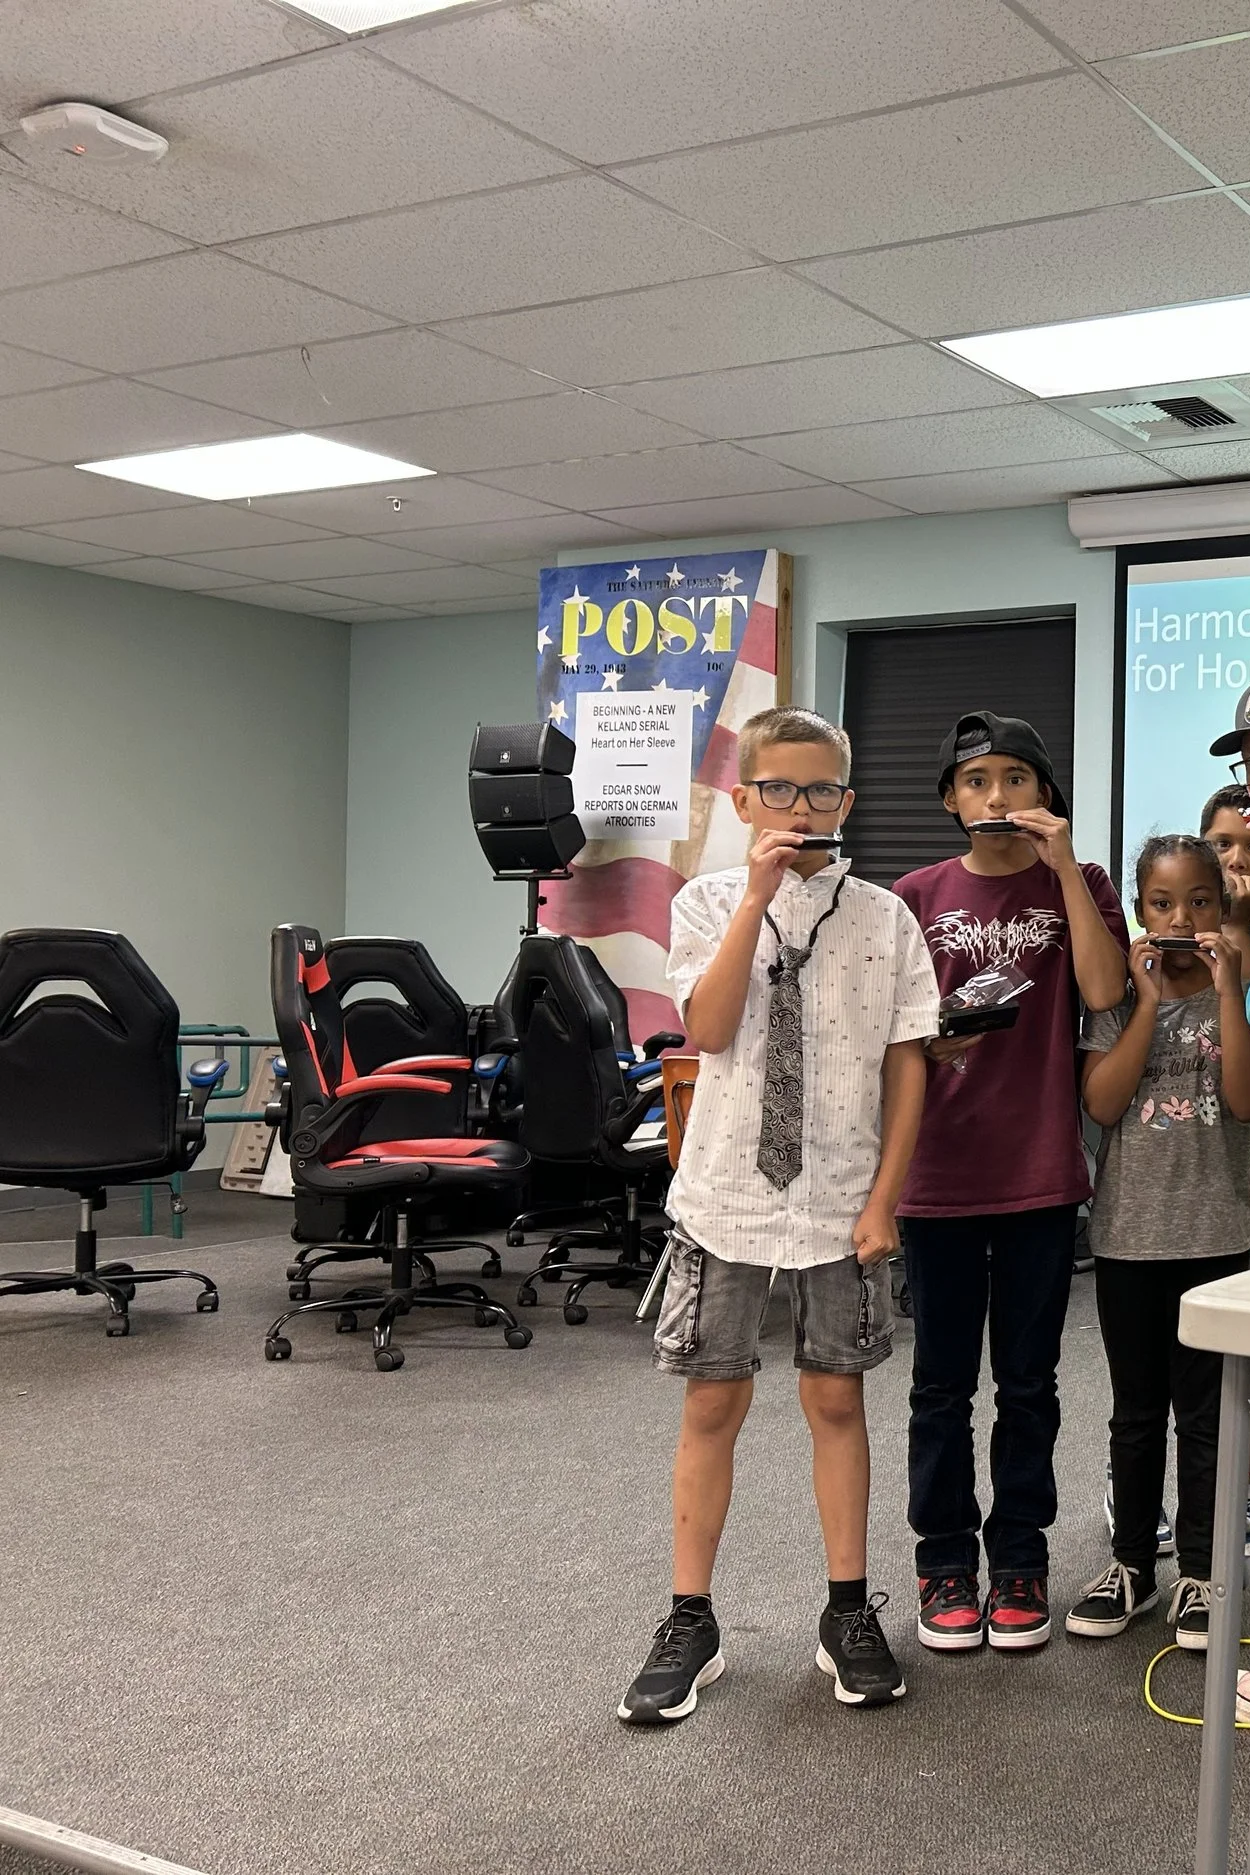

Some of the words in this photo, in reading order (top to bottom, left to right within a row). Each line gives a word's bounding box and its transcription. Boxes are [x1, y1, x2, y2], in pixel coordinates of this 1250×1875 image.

[607, 581, 627, 592] THE
[558, 595, 748, 657] POST
[561, 664, 581, 675] MAY
[585, 664, 599, 675] 29,
[604, 663, 626, 674] 1943
[1132, 654, 1185, 692] for
[593, 705, 641, 717] BEGINNING
[648, 705, 654, 715] A
[656, 704, 676, 715] NEW
[598, 721, 637, 732] KELLAND
[639, 721, 669, 731] SERIAL
[591, 738, 615, 749] Heart
[617, 740, 627, 748] on
[630, 737, 645, 748] Her
[647, 737, 675, 748] Sleeve
[602, 785, 632, 795] EDGAR
[634, 785, 661, 795] SNOW
[585, 800, 623, 811] REPORTS
[625, 801, 638, 811] ON
[640, 801, 678, 811] GERMAN
[605, 816, 656, 827] ATROCITIES
[1169, 1055, 1207, 1077] Wild
